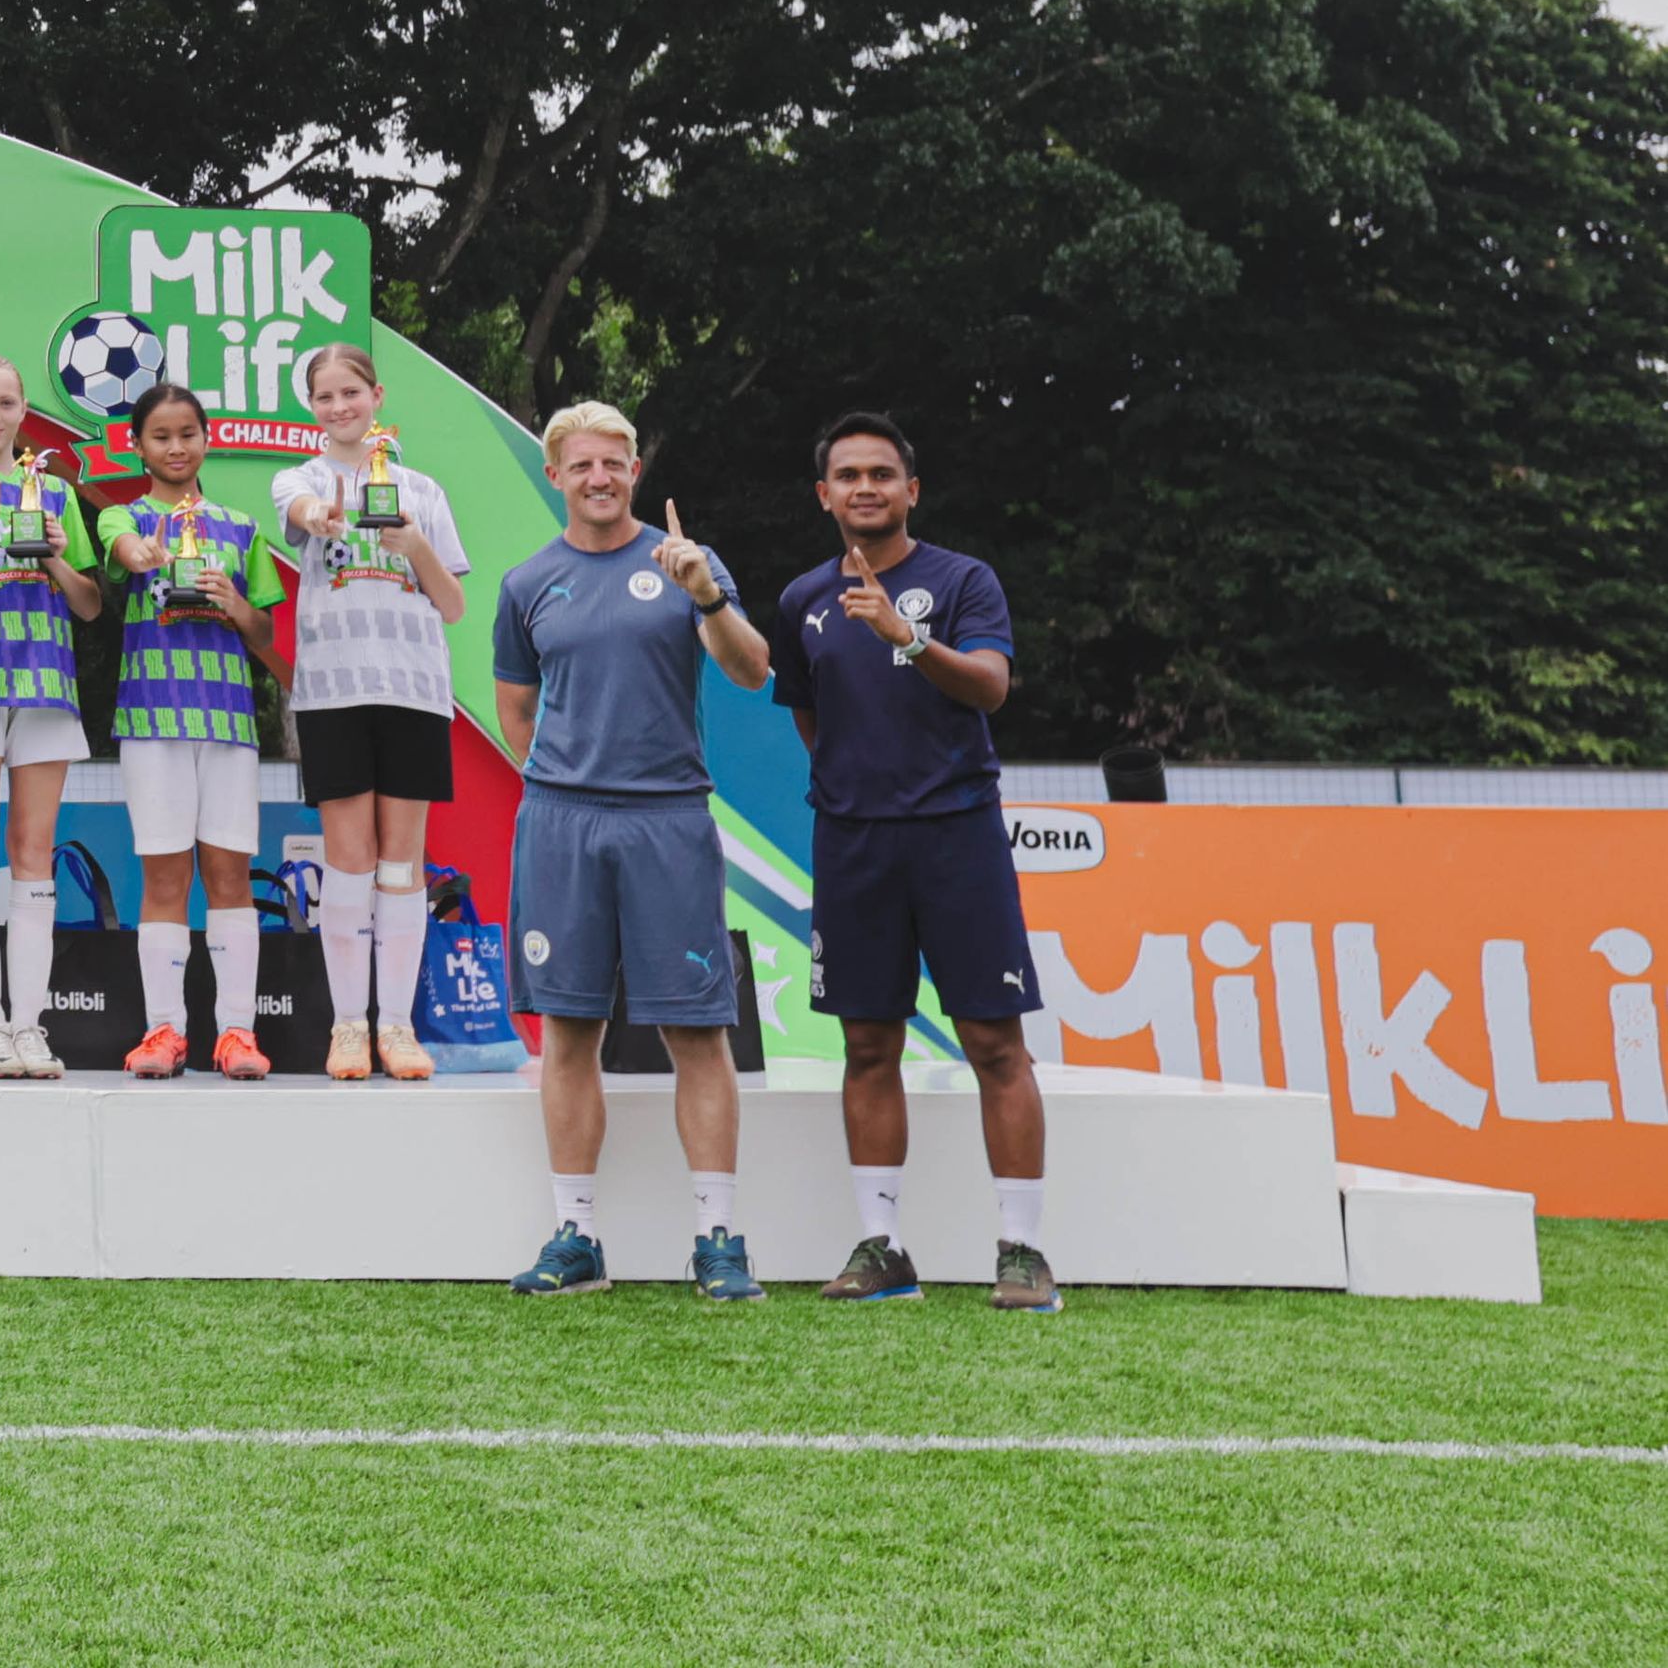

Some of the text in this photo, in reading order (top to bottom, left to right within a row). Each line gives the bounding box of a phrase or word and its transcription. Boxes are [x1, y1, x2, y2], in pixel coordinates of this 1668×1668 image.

[129, 226, 347, 324] Milk
[218, 422, 331, 453] CHALLENG
[54, 991, 105, 1012] blibli
[257, 995, 293, 1015] libli
